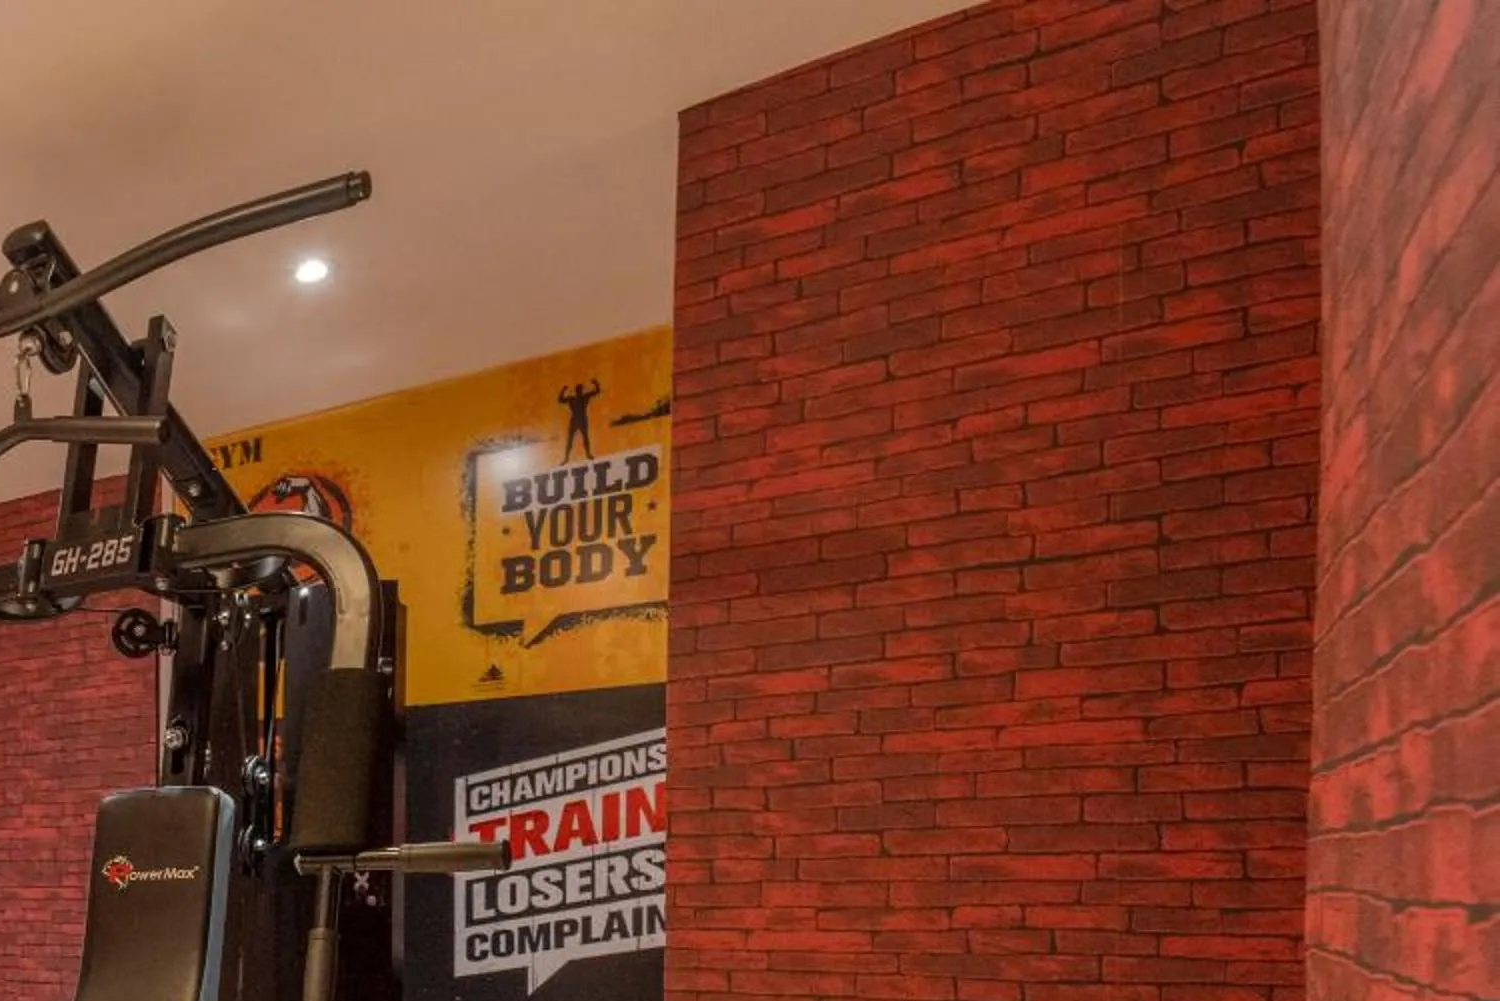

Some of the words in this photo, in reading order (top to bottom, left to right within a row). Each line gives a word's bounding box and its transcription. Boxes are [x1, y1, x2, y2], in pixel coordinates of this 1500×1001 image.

[502, 453, 658, 512] BUILD
[524, 494, 632, 549] YOUR
[501, 534, 656, 594] BODY
[469, 743, 666, 811] CHAMPIONS
[469, 781, 666, 861] TRAIN
[472, 849, 665, 920] LOSERS
[466, 904, 665, 961] COMPLAIN
